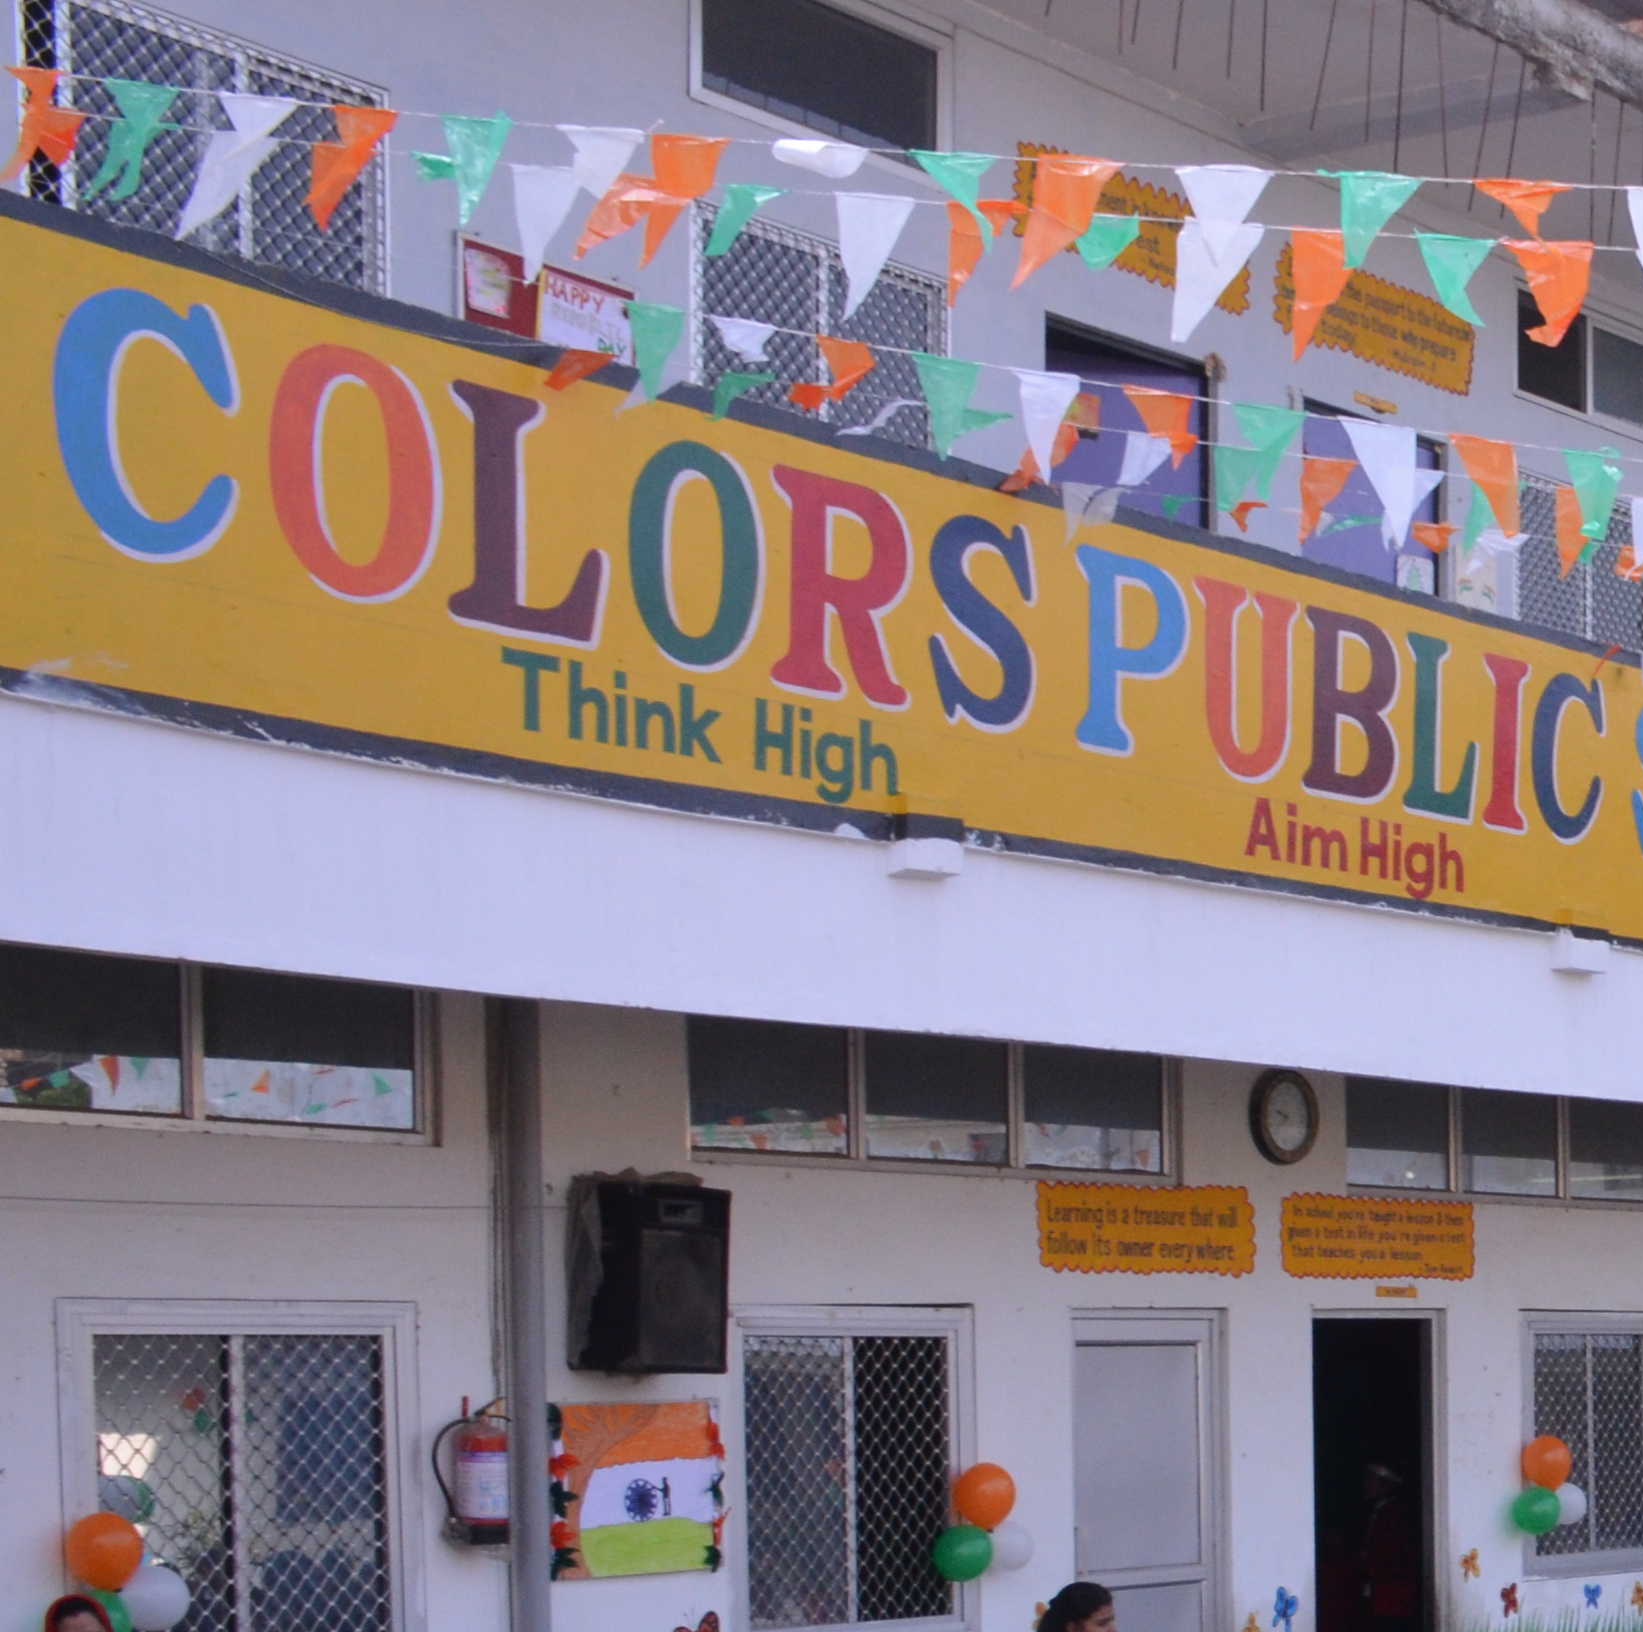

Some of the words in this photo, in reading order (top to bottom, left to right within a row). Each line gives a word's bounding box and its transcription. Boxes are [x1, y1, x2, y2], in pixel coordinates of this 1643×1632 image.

[544, 274, 605, 315] HAPPY
[53, 287, 1038, 735] COLORS
[1074, 543, 1607, 847] PUBLIC
[500, 646, 722, 764] Think
[755, 705, 900, 803] High
[1245, 797, 1350, 876] Aim
[1360, 817, 1466, 901] High
[1047, 1198, 1104, 1229] Learning
[1106, 1200, 1118, 1225] is
[1121, 1207, 1130, 1224] a
[1134, 1204, 1186, 1227] treasure
[1190, 1205, 1214, 1227] that
[1217, 1206, 1239, 1229] will
[1047, 1230, 1088, 1255] follow
[1092, 1232, 1112, 1257] its
[1117, 1240, 1155, 1259] owner
